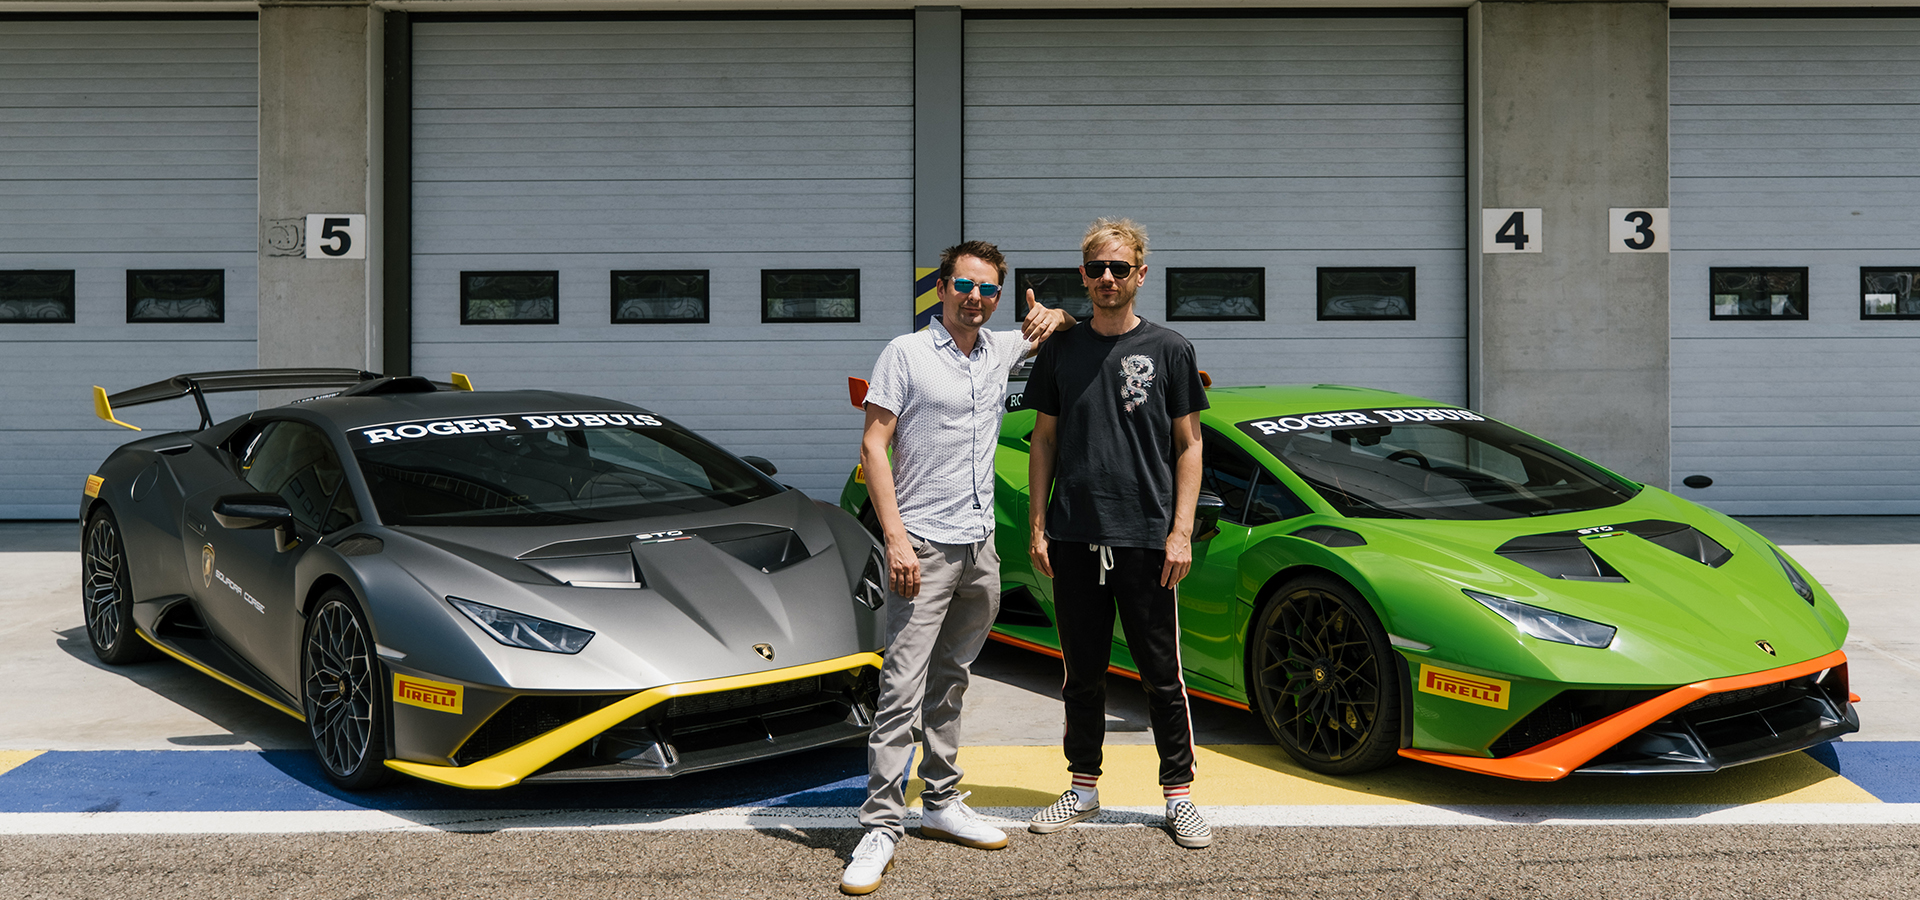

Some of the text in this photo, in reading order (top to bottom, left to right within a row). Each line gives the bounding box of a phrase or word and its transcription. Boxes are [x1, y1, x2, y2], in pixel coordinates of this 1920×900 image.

[320, 217, 351, 256] 5
[1495, 211, 1529, 250] 4
[1623, 211, 1655, 250] 3
[363, 414, 663, 444] ROGER DUBUIS
[1250, 408, 1485, 435] ROGER DUBUIS
[635, 530, 683, 540] STO
[1577, 525, 1614, 535] STO
[243, 591, 266, 614] CORSE
[399, 680, 457, 708] PIRELLI
[1426, 670, 1502, 703] PIRELLI
